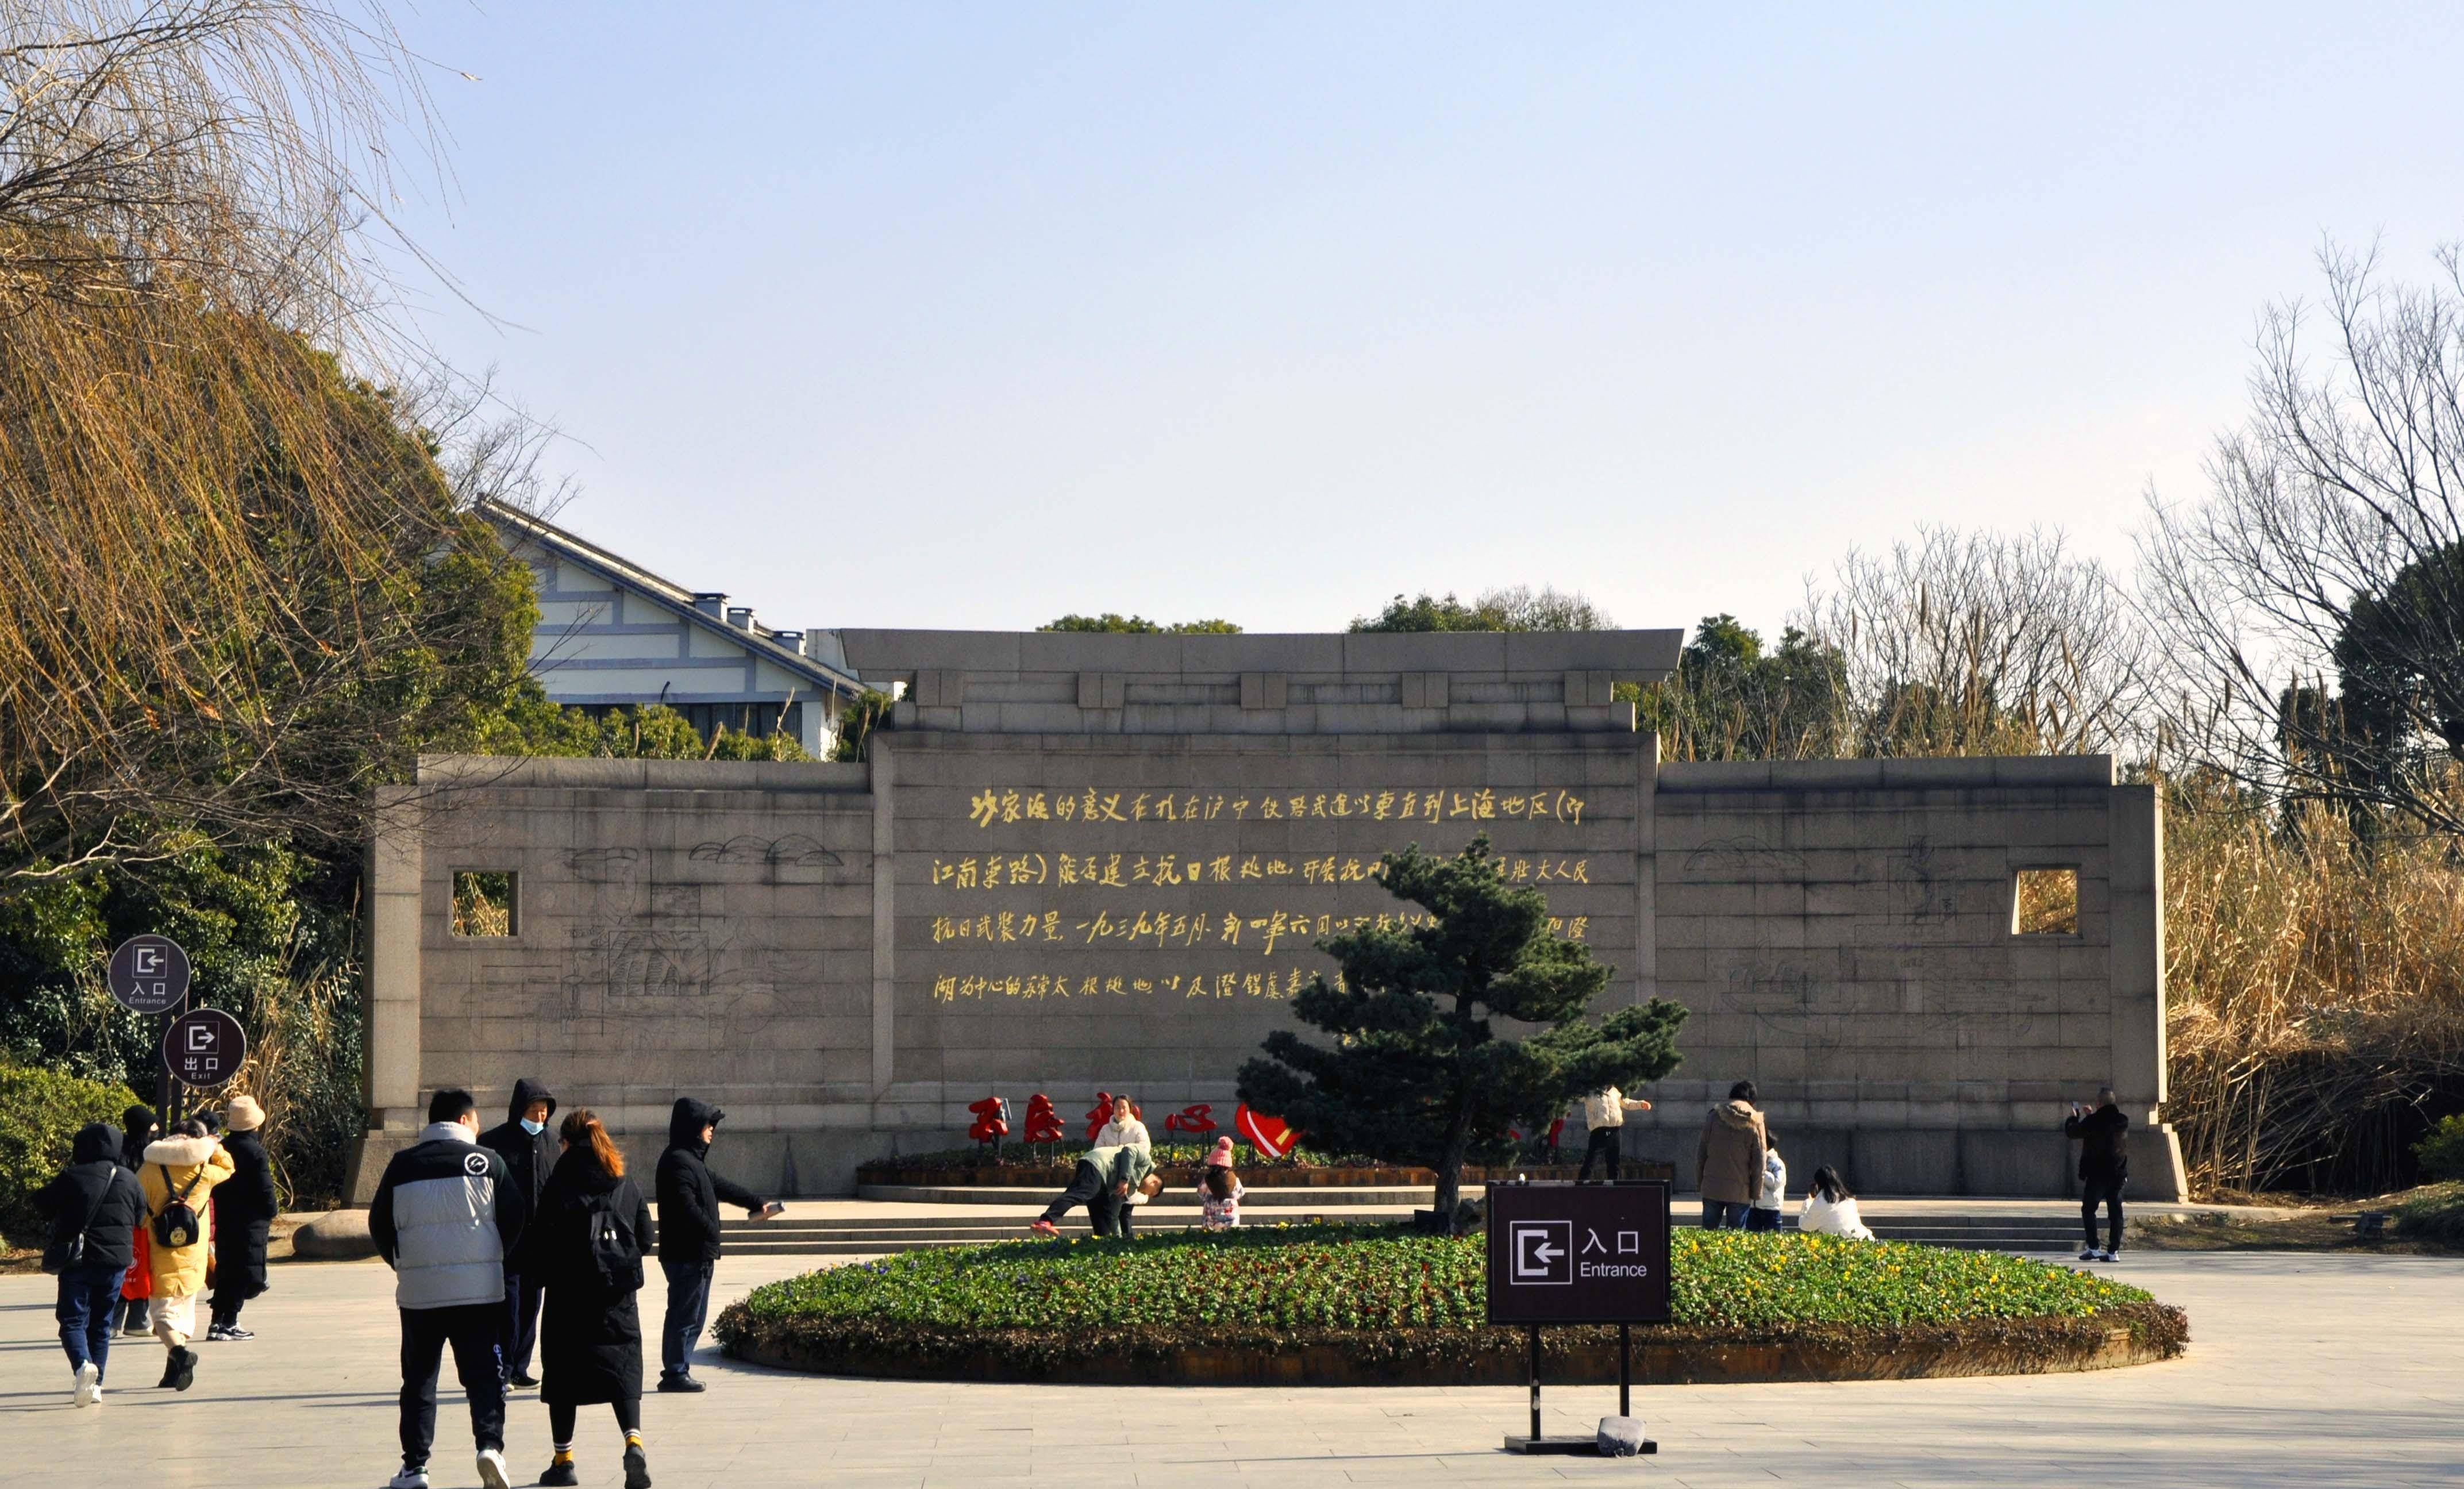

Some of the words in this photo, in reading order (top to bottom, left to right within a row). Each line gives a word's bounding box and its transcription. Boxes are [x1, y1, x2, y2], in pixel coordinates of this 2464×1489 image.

[131, 982, 165, 995] 入口
[129, 996, 166, 1005] Entrance
[184, 1057, 218, 1071] 出口
[1581, 1228, 1639, 1255] 入口
[1580, 1261, 1647, 1277] Entrance
